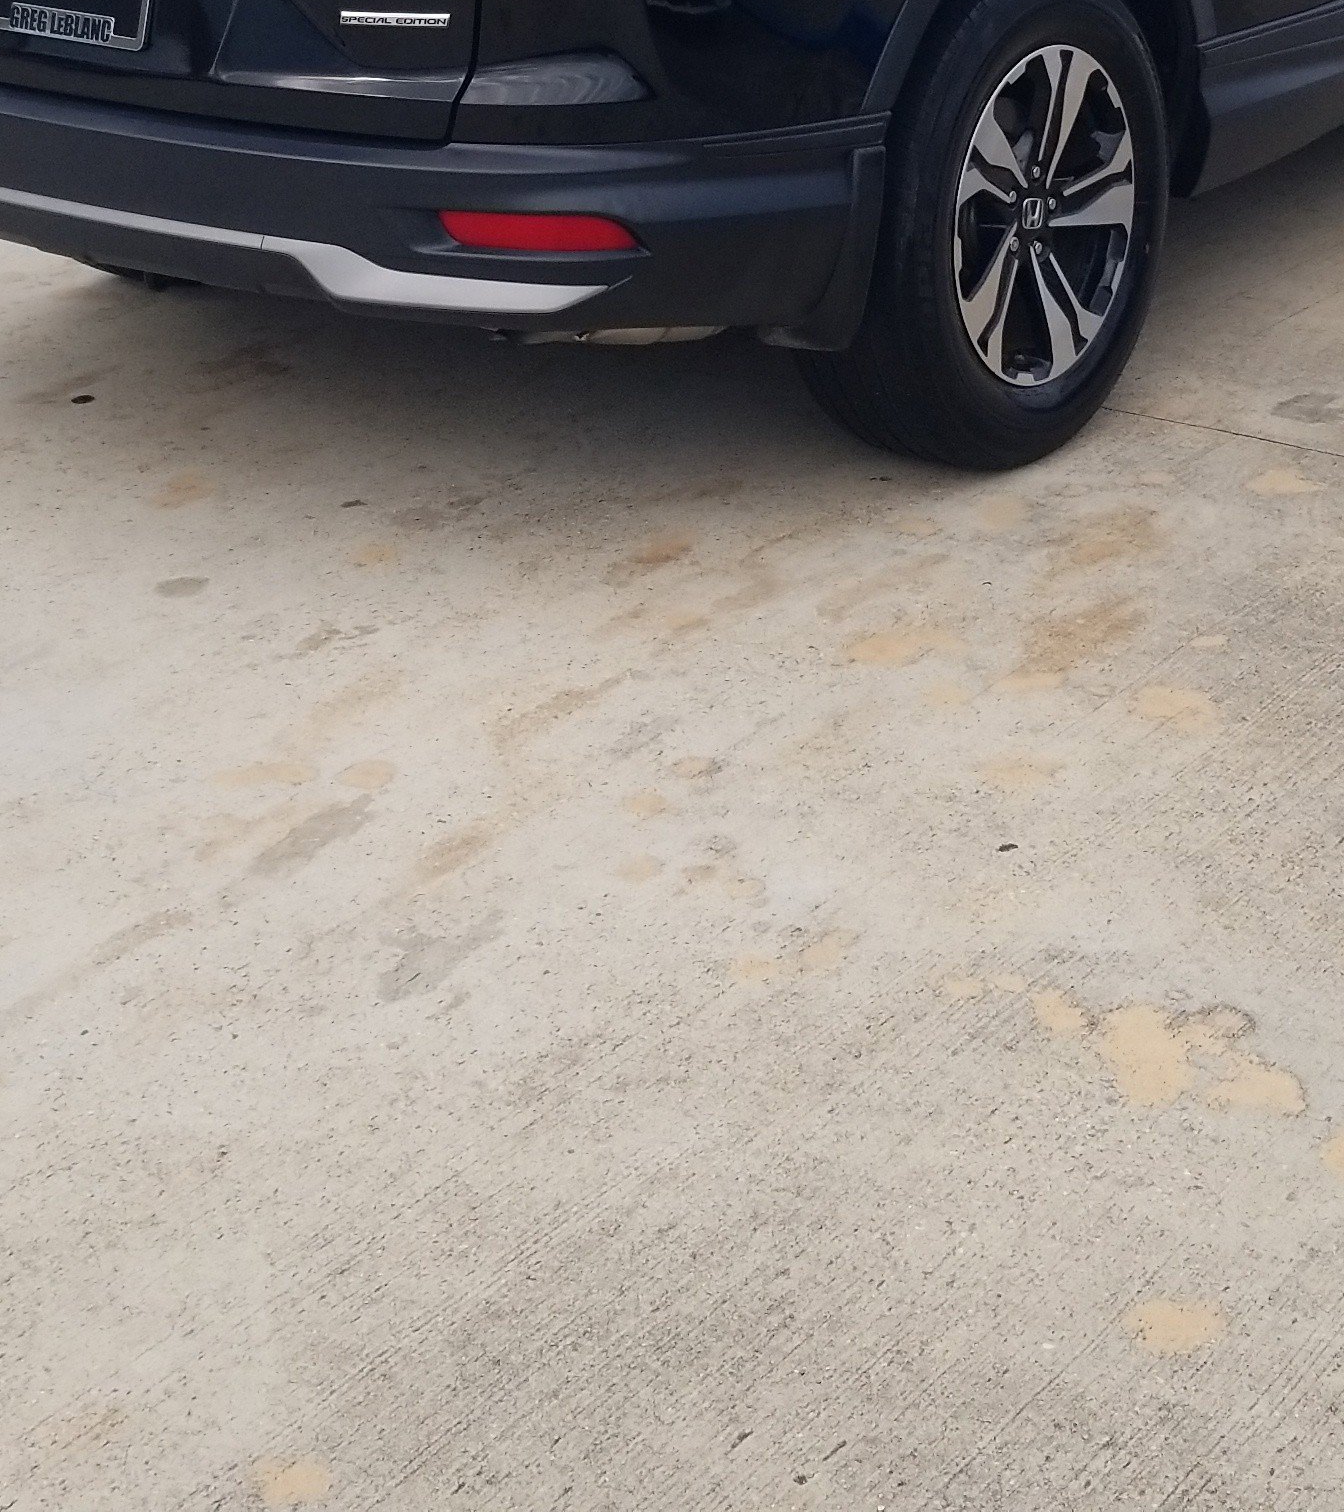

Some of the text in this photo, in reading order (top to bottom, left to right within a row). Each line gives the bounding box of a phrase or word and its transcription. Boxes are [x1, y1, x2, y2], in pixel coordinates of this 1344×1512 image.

[9, 5, 48, 32] GREG
[341, 16, 447, 25] SPECIAL EDITION
